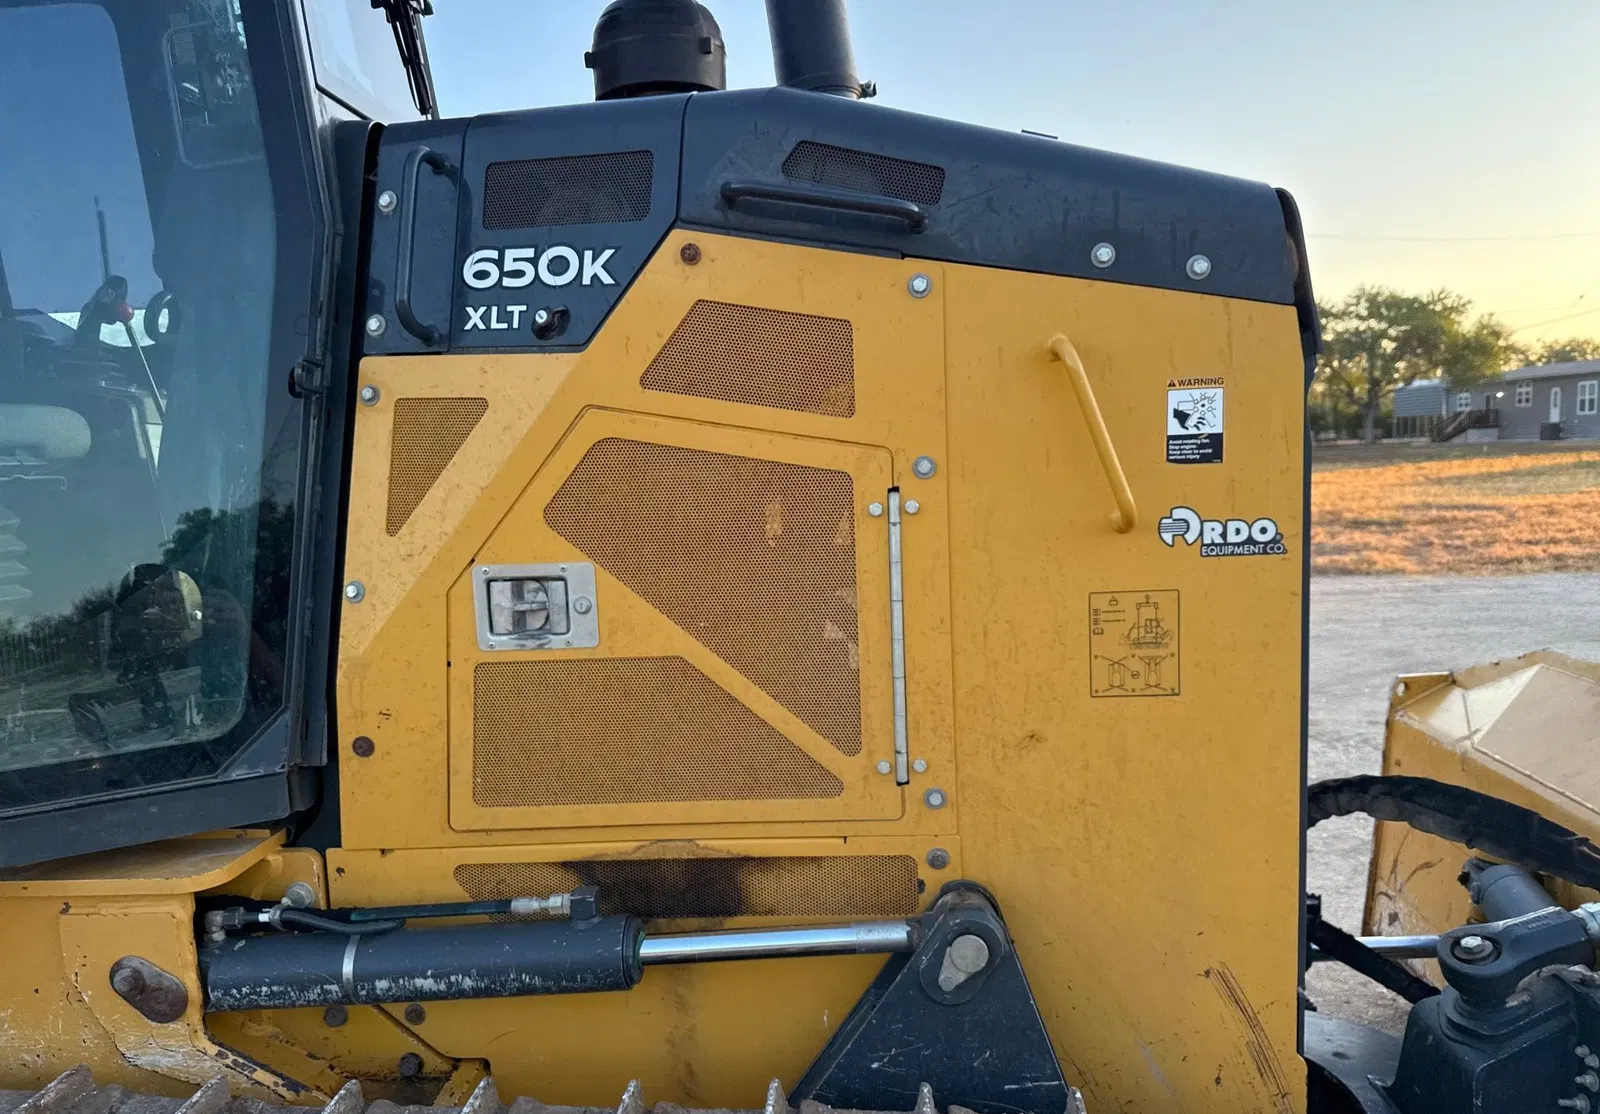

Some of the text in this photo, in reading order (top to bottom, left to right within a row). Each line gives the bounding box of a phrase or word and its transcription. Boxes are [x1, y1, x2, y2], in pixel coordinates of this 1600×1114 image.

[463, 246, 616, 289] 650K
[463, 305, 527, 330] XLT
[1177, 377, 1224, 387] WARNING
[1201, 543, 1287, 556] EQUIPMENT CO.
